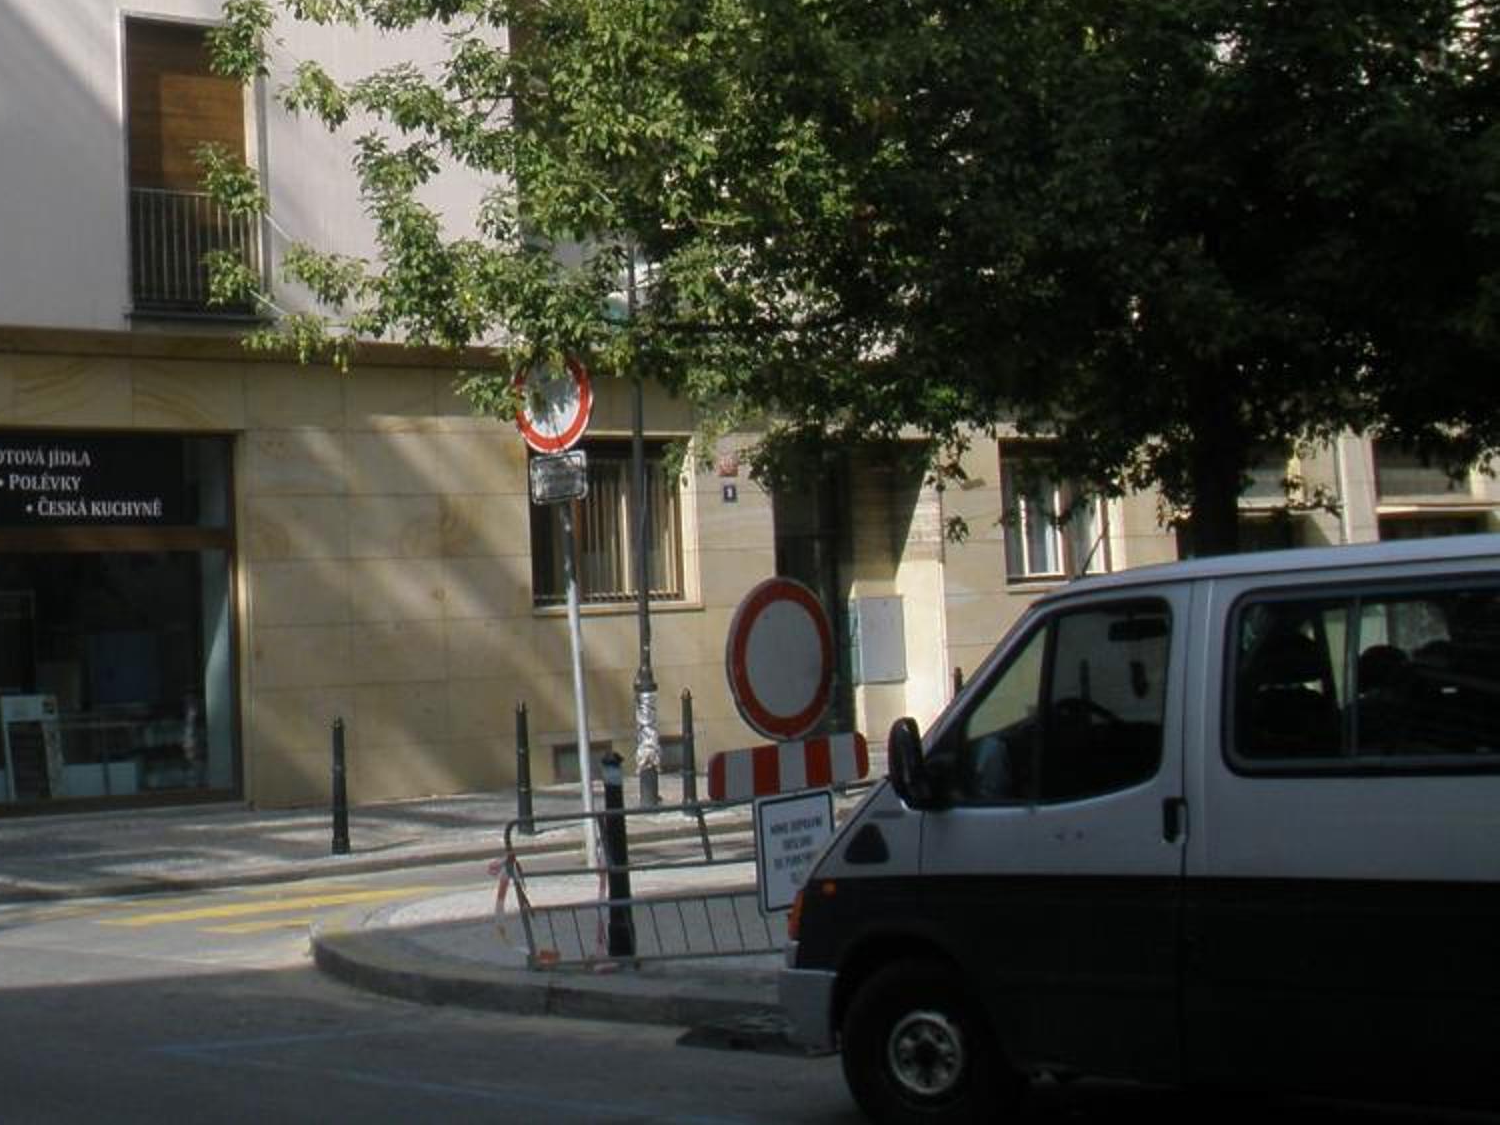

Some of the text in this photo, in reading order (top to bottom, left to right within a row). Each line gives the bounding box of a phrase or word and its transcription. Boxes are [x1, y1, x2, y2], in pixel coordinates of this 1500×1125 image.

[49, 447, 90, 468] JÍDLA
[8, 471, 81, 491] POLÉVKY
[37, 495, 162, 517] ČESKÁ KUCHYNĚ
